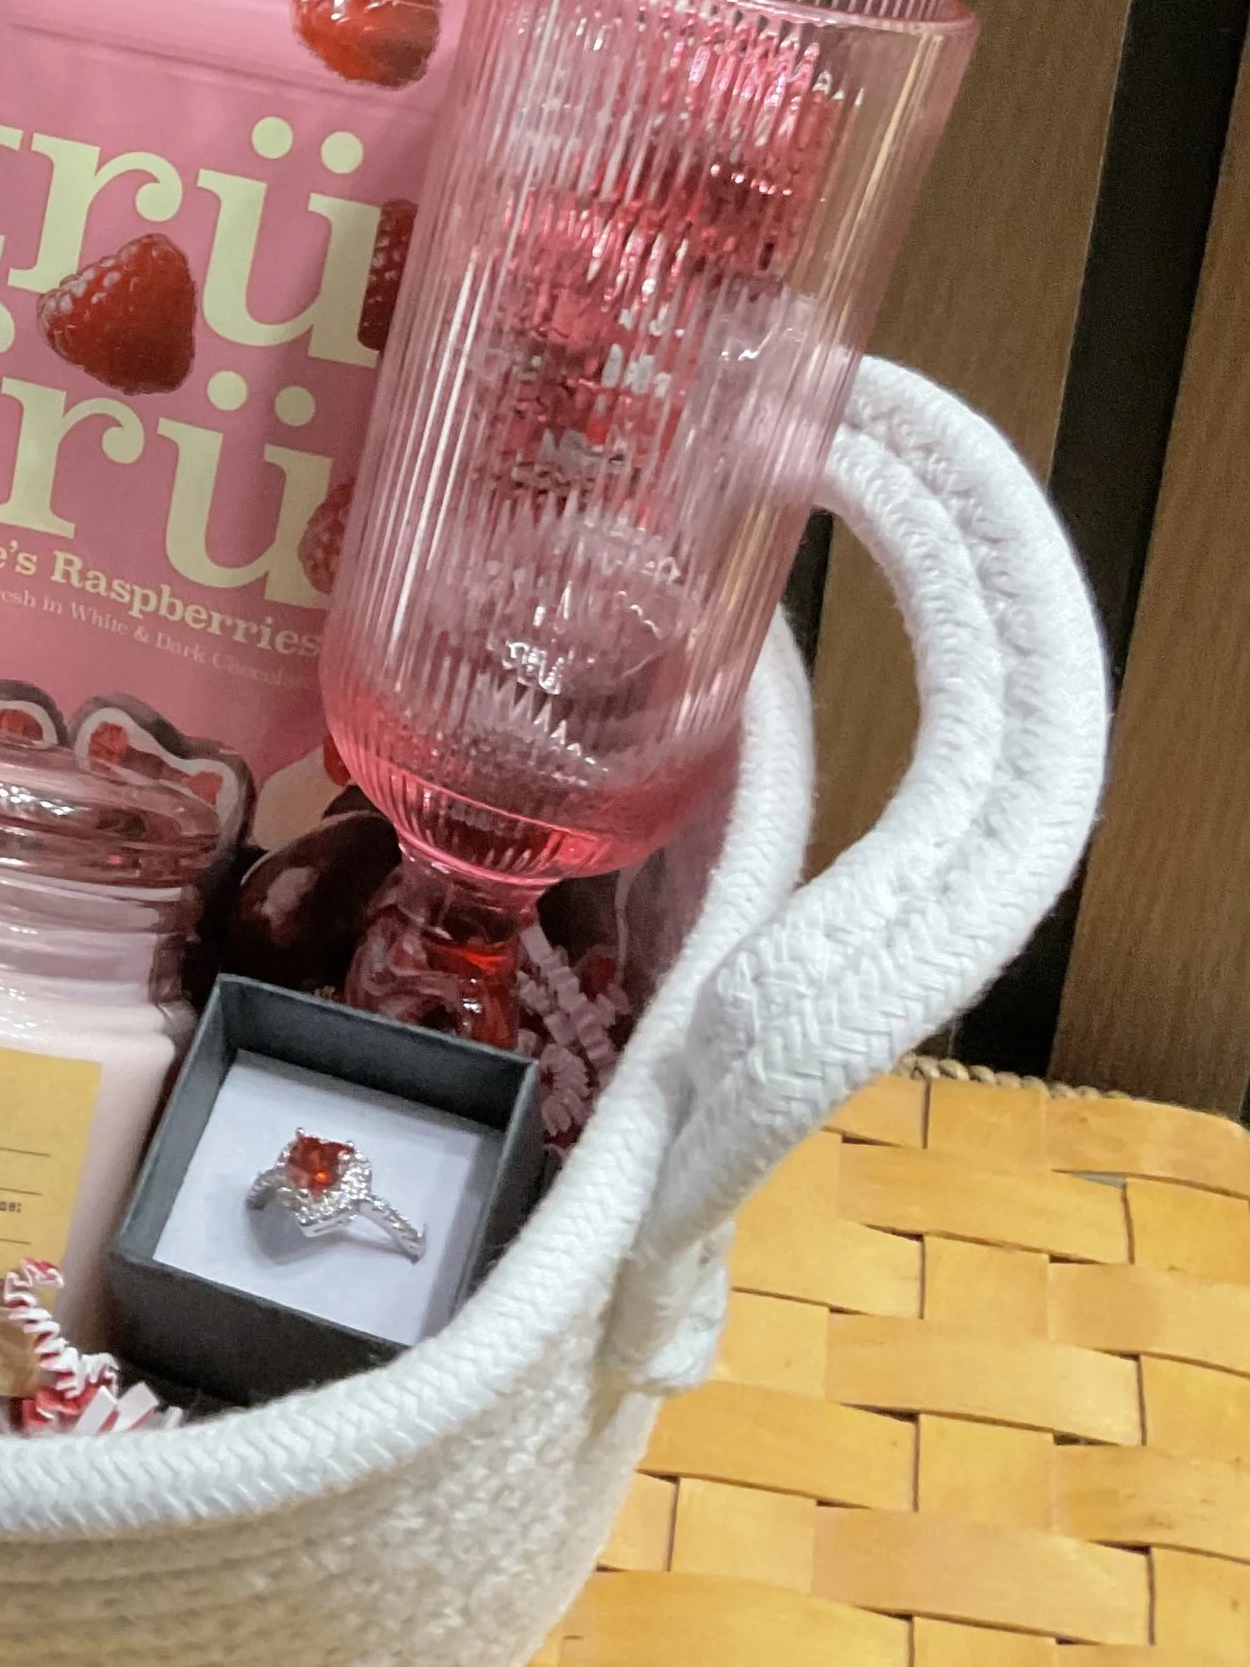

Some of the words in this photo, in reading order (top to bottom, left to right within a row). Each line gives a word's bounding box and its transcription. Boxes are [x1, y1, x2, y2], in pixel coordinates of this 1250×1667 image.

[43, 590, 63, 615] in
[71, 600, 129, 636] White
[134, 626, 149, 644] &
[155, 632, 207, 665] Dark
[50, 550, 321, 657] Raspberries
